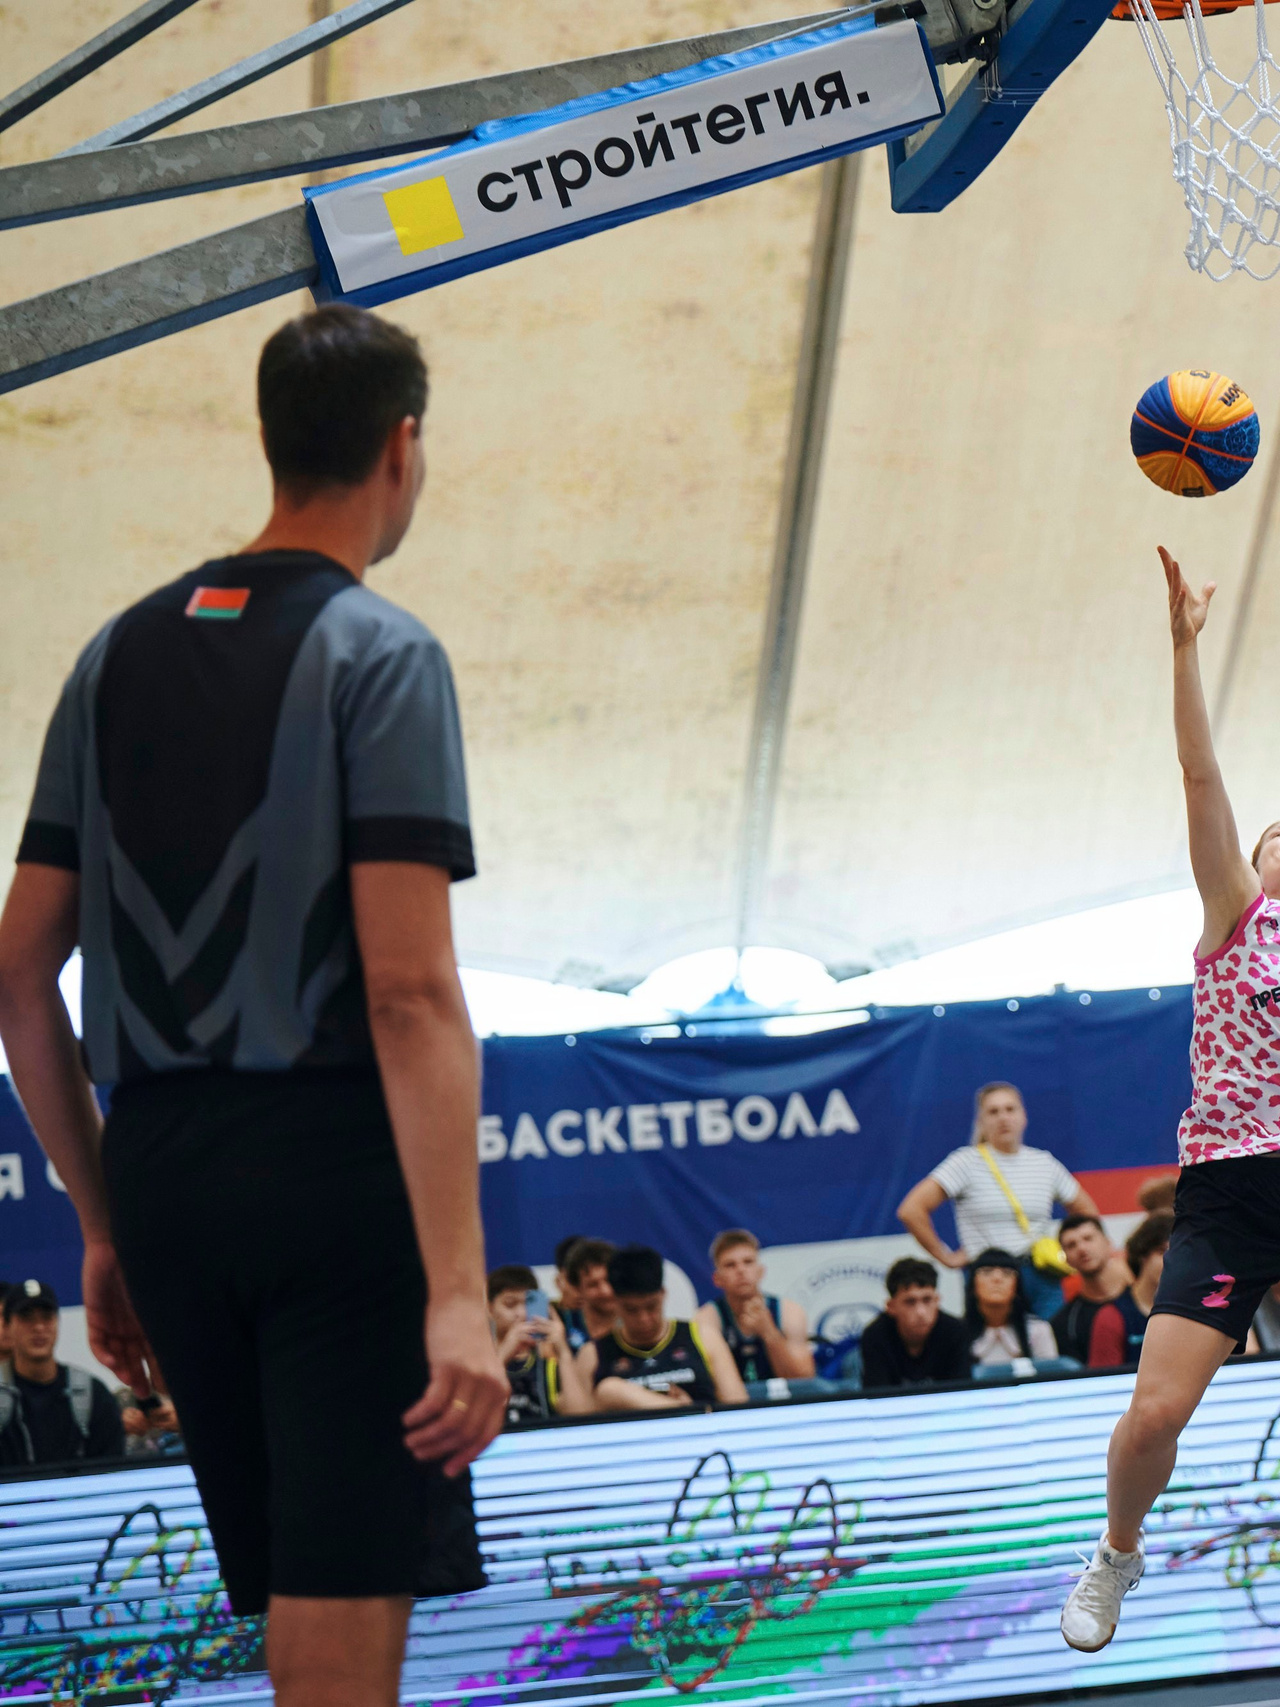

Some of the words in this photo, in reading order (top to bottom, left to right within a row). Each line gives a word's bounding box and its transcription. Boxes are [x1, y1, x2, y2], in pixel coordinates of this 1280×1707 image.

[477, 70, 871, 213] стройтегия.
[477, 1088, 861, 1163] БАСКЕТБОЛА
[1201, 1273, 1236, 1309] 2
